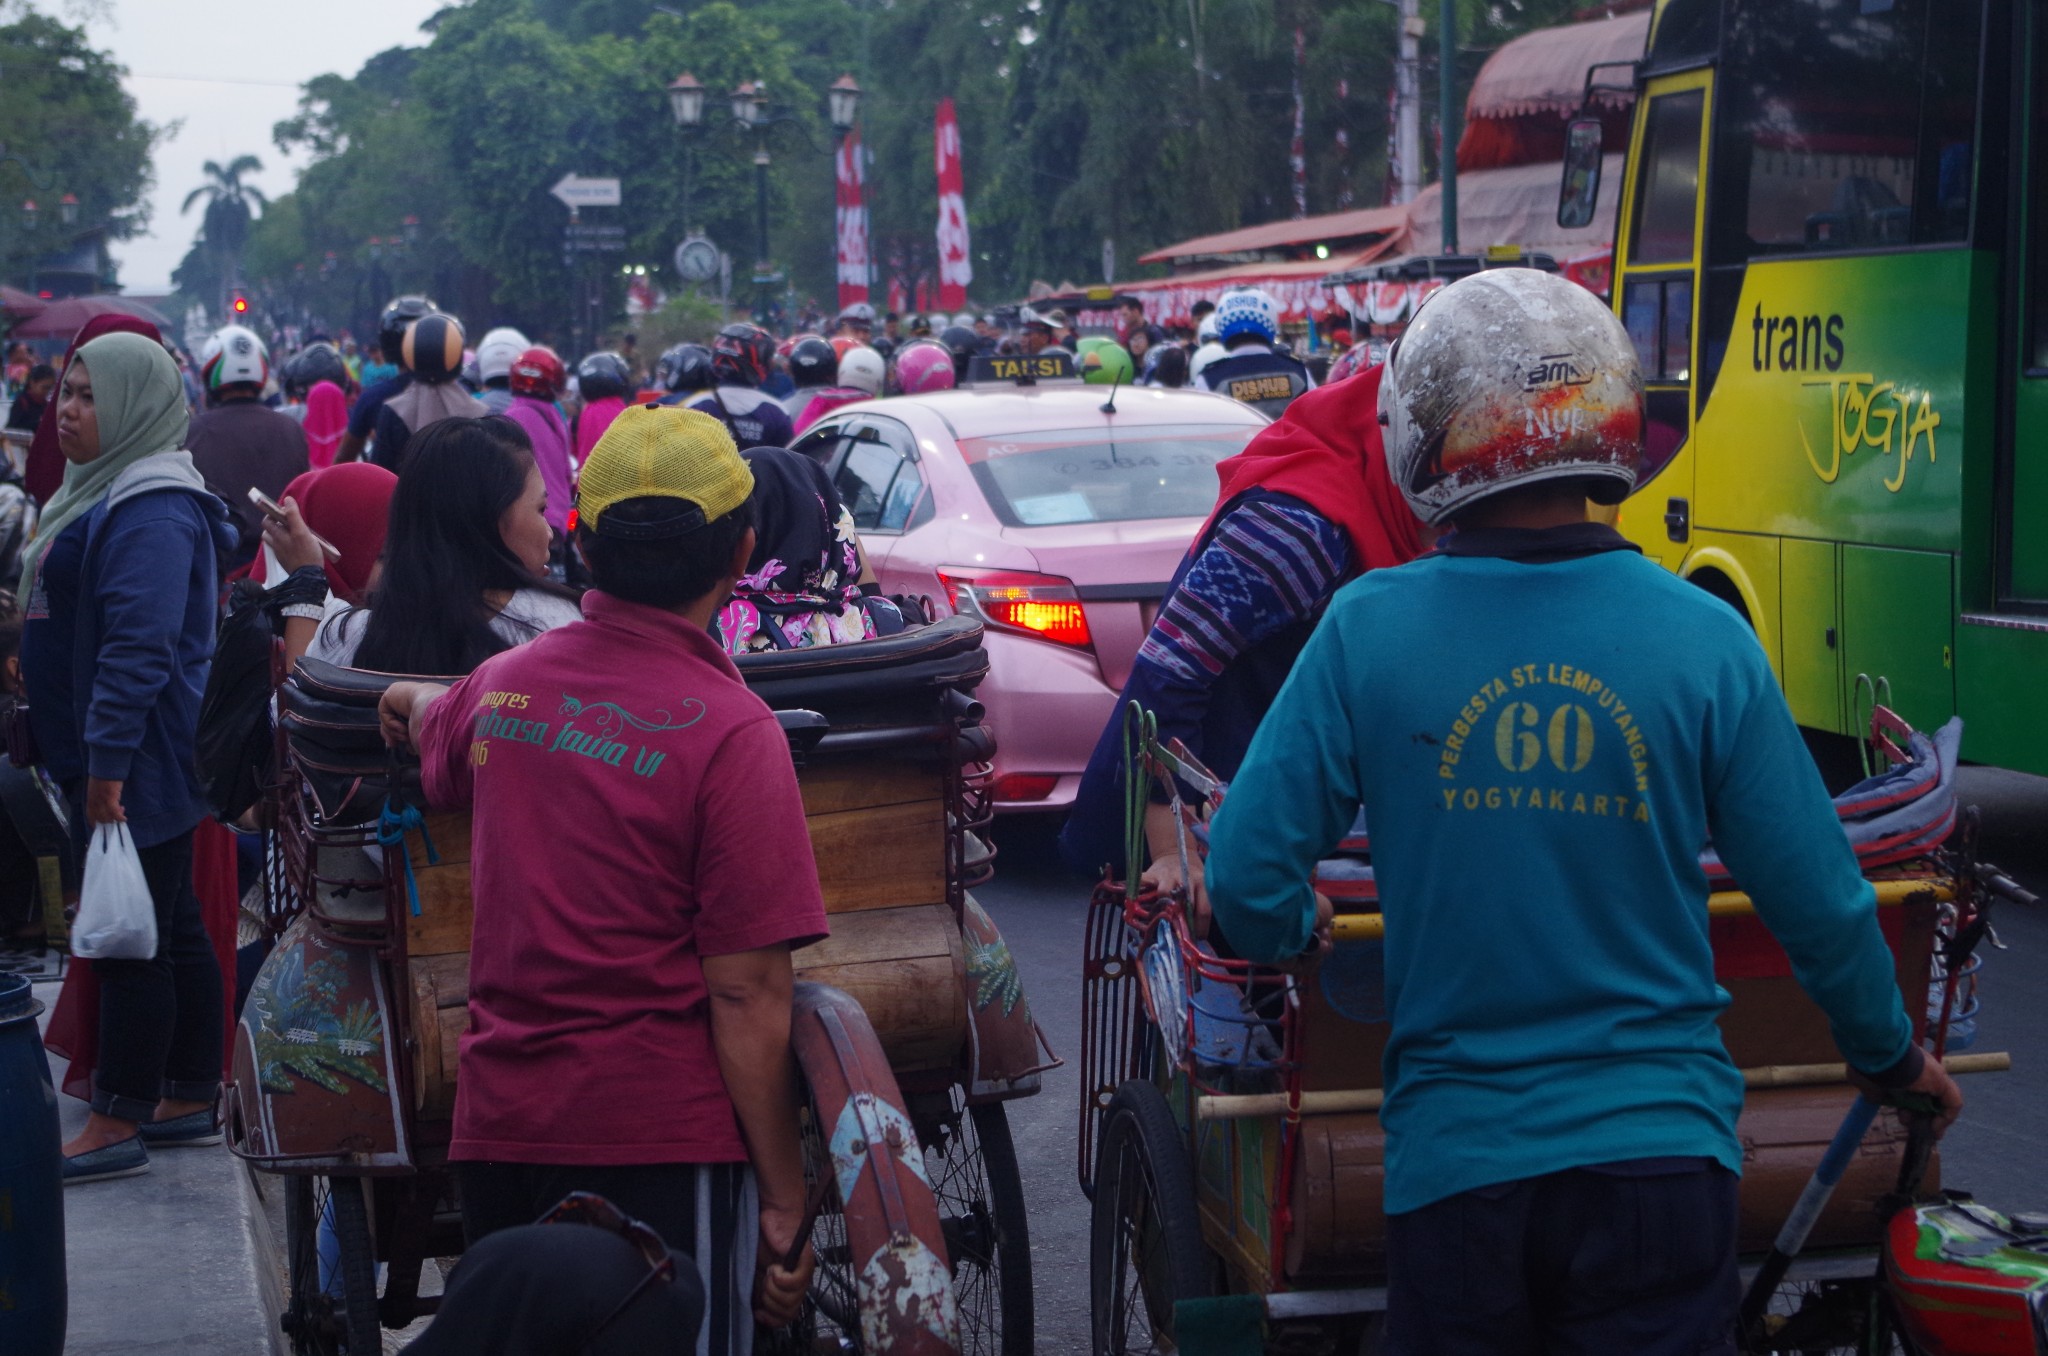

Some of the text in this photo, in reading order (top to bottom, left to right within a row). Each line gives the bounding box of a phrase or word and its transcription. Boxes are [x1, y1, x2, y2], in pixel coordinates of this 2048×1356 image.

[1227, 297, 1257, 309] DISHUB
[1753, 301, 1844, 372] trans
[1232, 377, 1289, 395] DISHUB
[1525, 407, 1587, 438] NUR
[1798, 373, 1940, 492] JOGJA
[1440, 662, 1649, 792] PERBESTA ST. LEMPUYANGAN
[1494, 702, 1595, 773] 60
[1443, 786, 1649, 822] YOGYAKARTA
